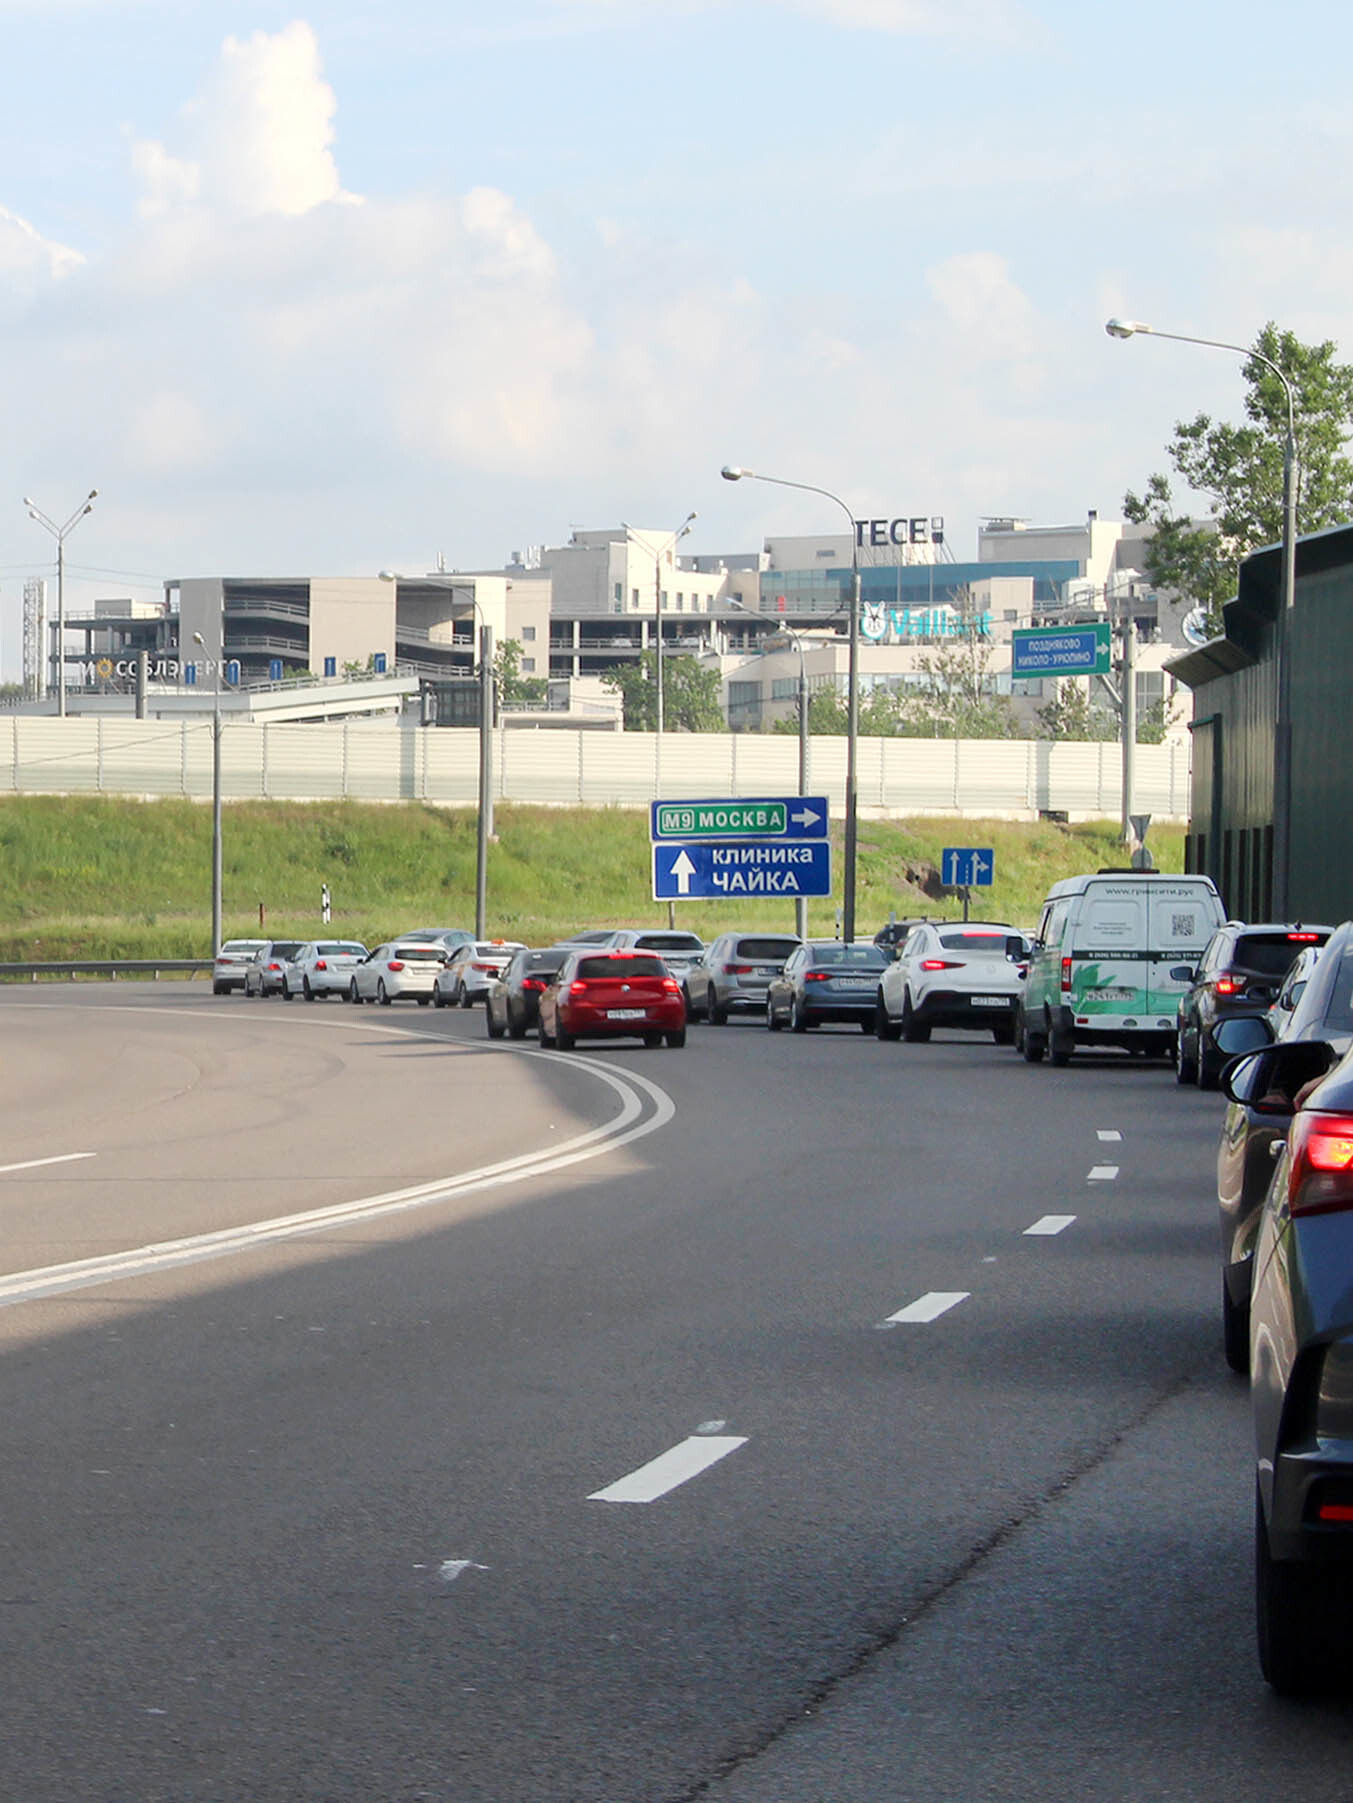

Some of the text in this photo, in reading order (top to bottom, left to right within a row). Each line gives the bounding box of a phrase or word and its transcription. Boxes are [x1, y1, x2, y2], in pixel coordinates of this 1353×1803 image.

[854, 518, 928, 547] TECE
[664, 811, 782, 829] М9 МОСКВА
[712, 848, 814, 865] клиника
[712, 867, 800, 892] ЧАЙКА
